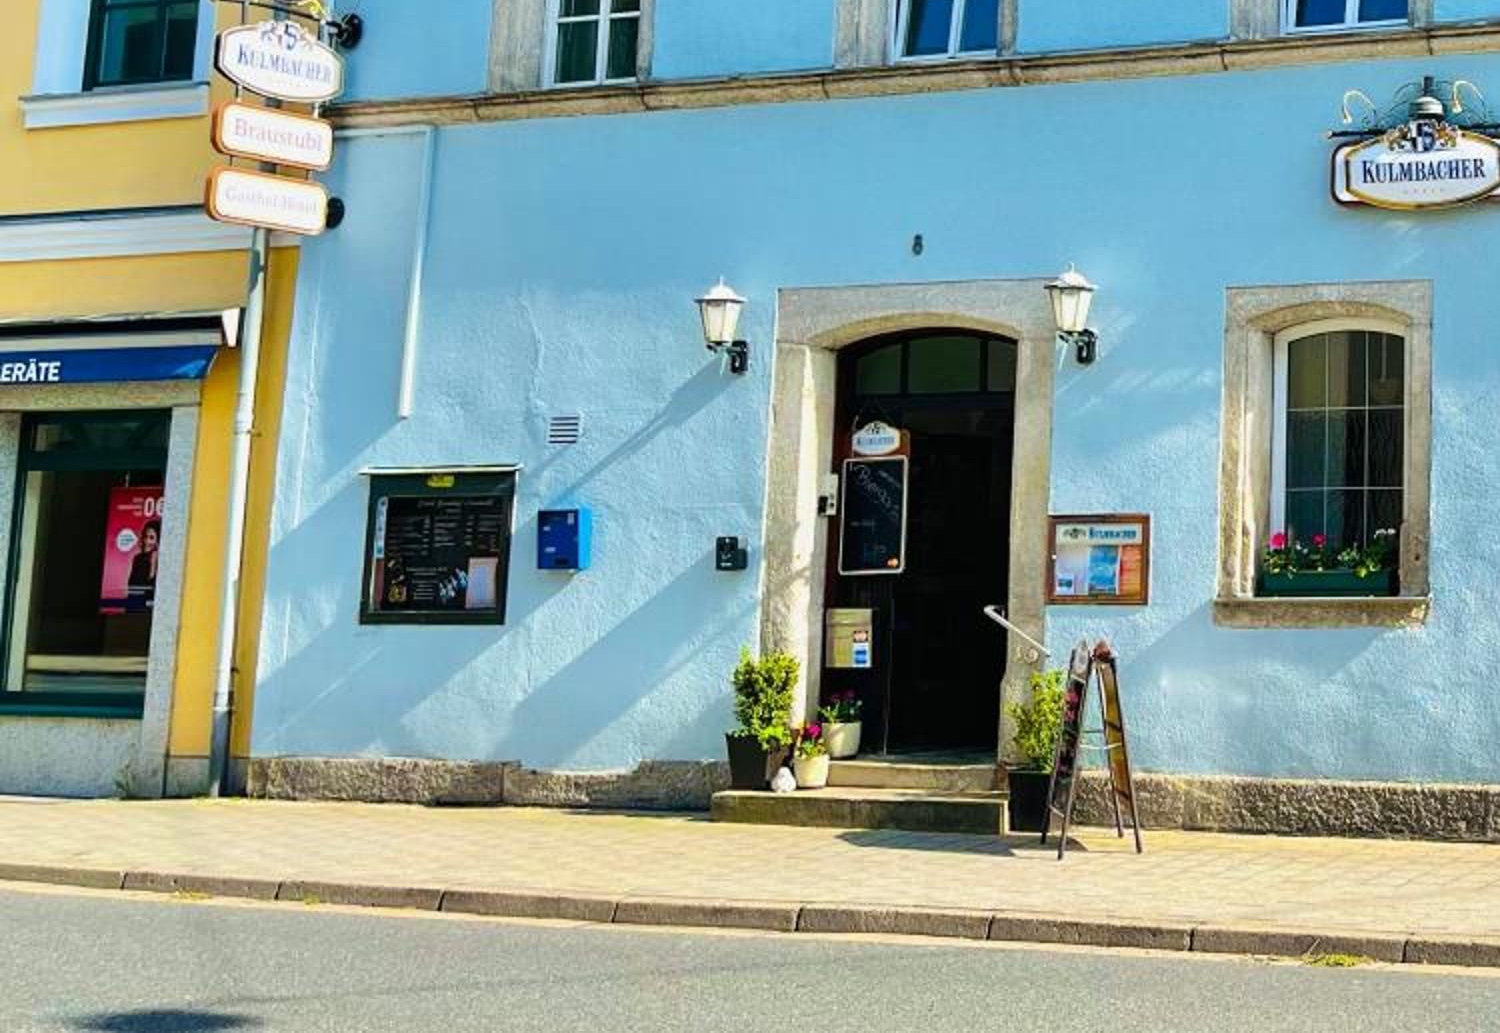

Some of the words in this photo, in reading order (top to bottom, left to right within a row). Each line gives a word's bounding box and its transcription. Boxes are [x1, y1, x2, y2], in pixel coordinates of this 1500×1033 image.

[237, 43, 332, 83] KULMBACHER
[1361, 158, 1487, 184] KULMBACHER
[0, 358, 61, 382] ERÄTE
